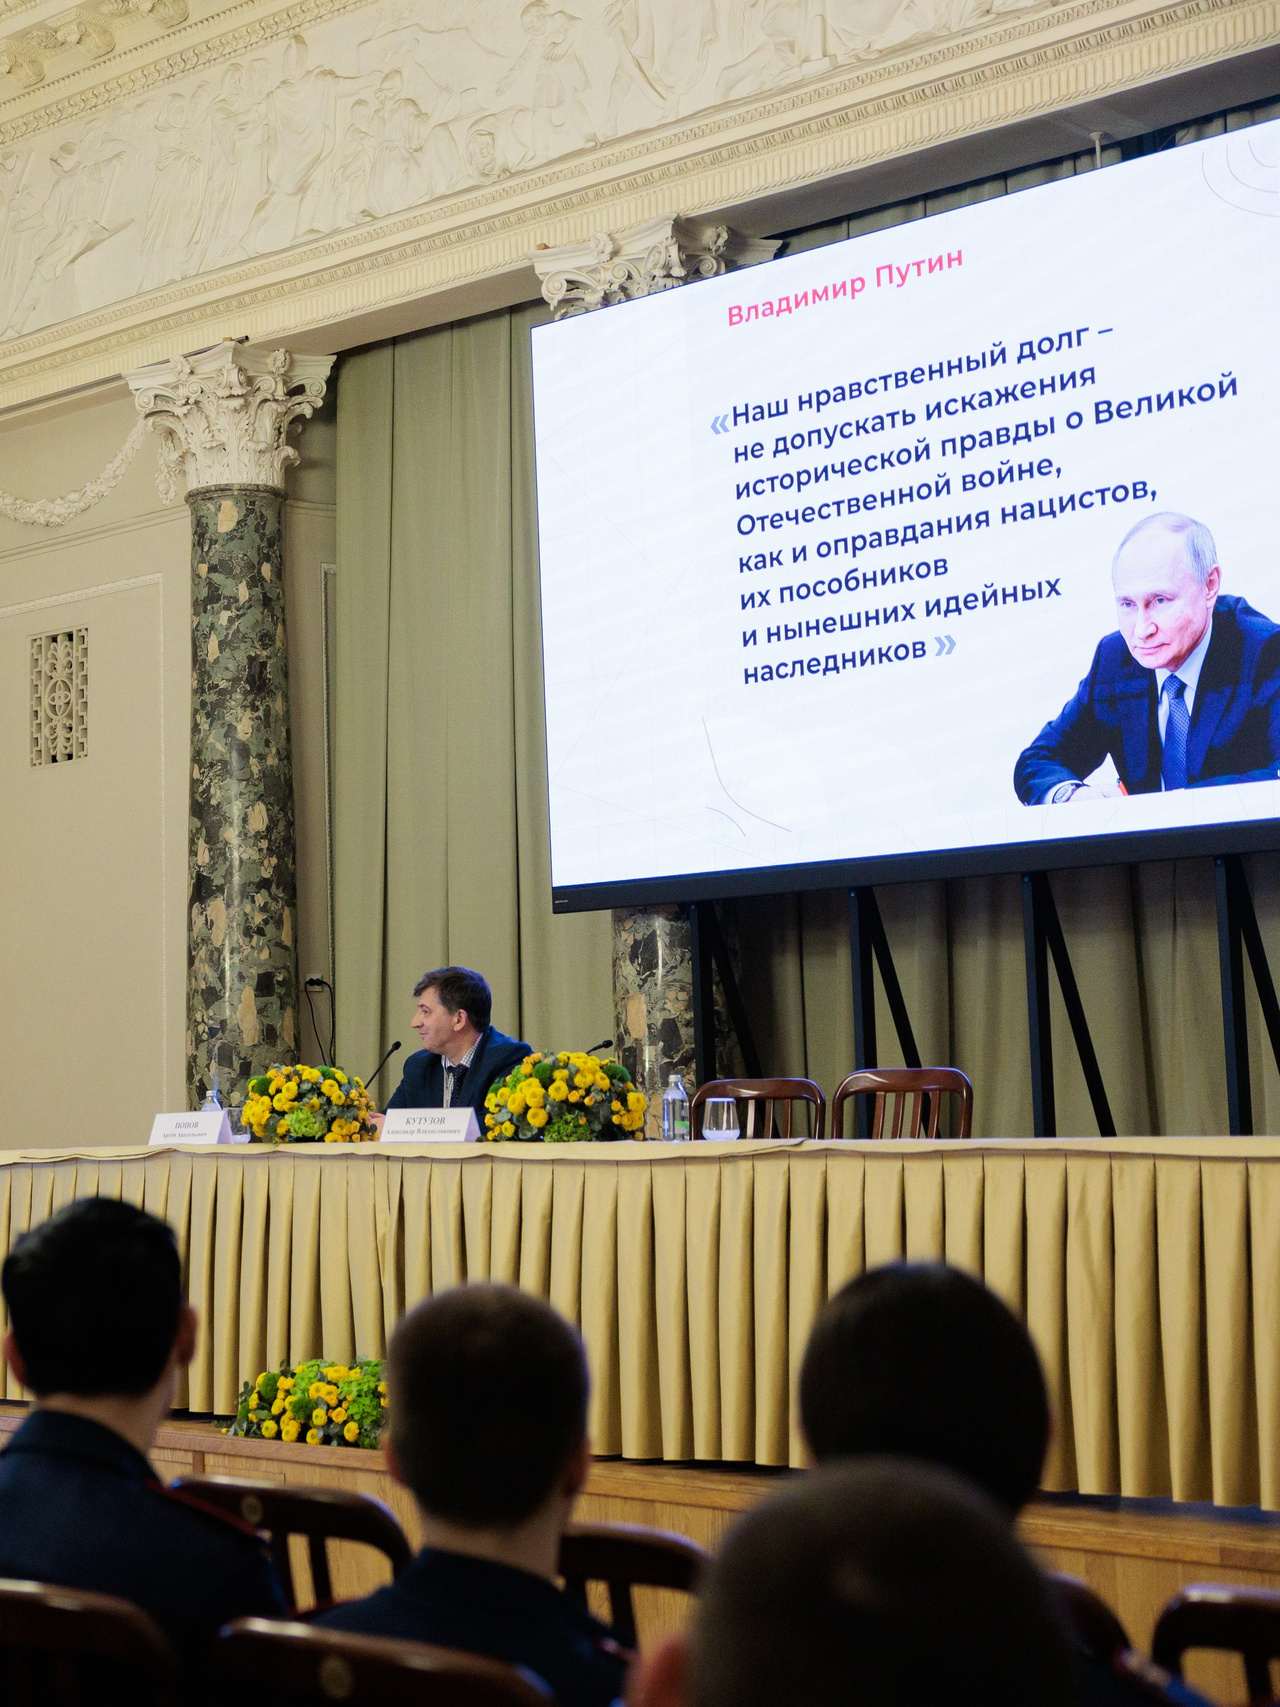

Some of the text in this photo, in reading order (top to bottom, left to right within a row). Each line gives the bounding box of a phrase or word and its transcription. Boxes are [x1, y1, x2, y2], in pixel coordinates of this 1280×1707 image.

[727, 249, 963, 327] Владимир Путин
[797, 340, 1008, 414] нравственный
[1016, 326, 1090, 365] долг
[733, 365, 1096, 464] не допускать искажения
[735, 370, 1238, 501] исторической правды о Великой
[736, 457, 1062, 537] Отечественной войне,
[738, 480, 1158, 574] как и оправдания нацистов,
[740, 557, 949, 611] их пособников
[741, 577, 1063, 648] и нынешних идейных
[174, 1121, 200, 1130] ПОПОВ
[405, 1116, 446, 1125] КУТУЗОВ
